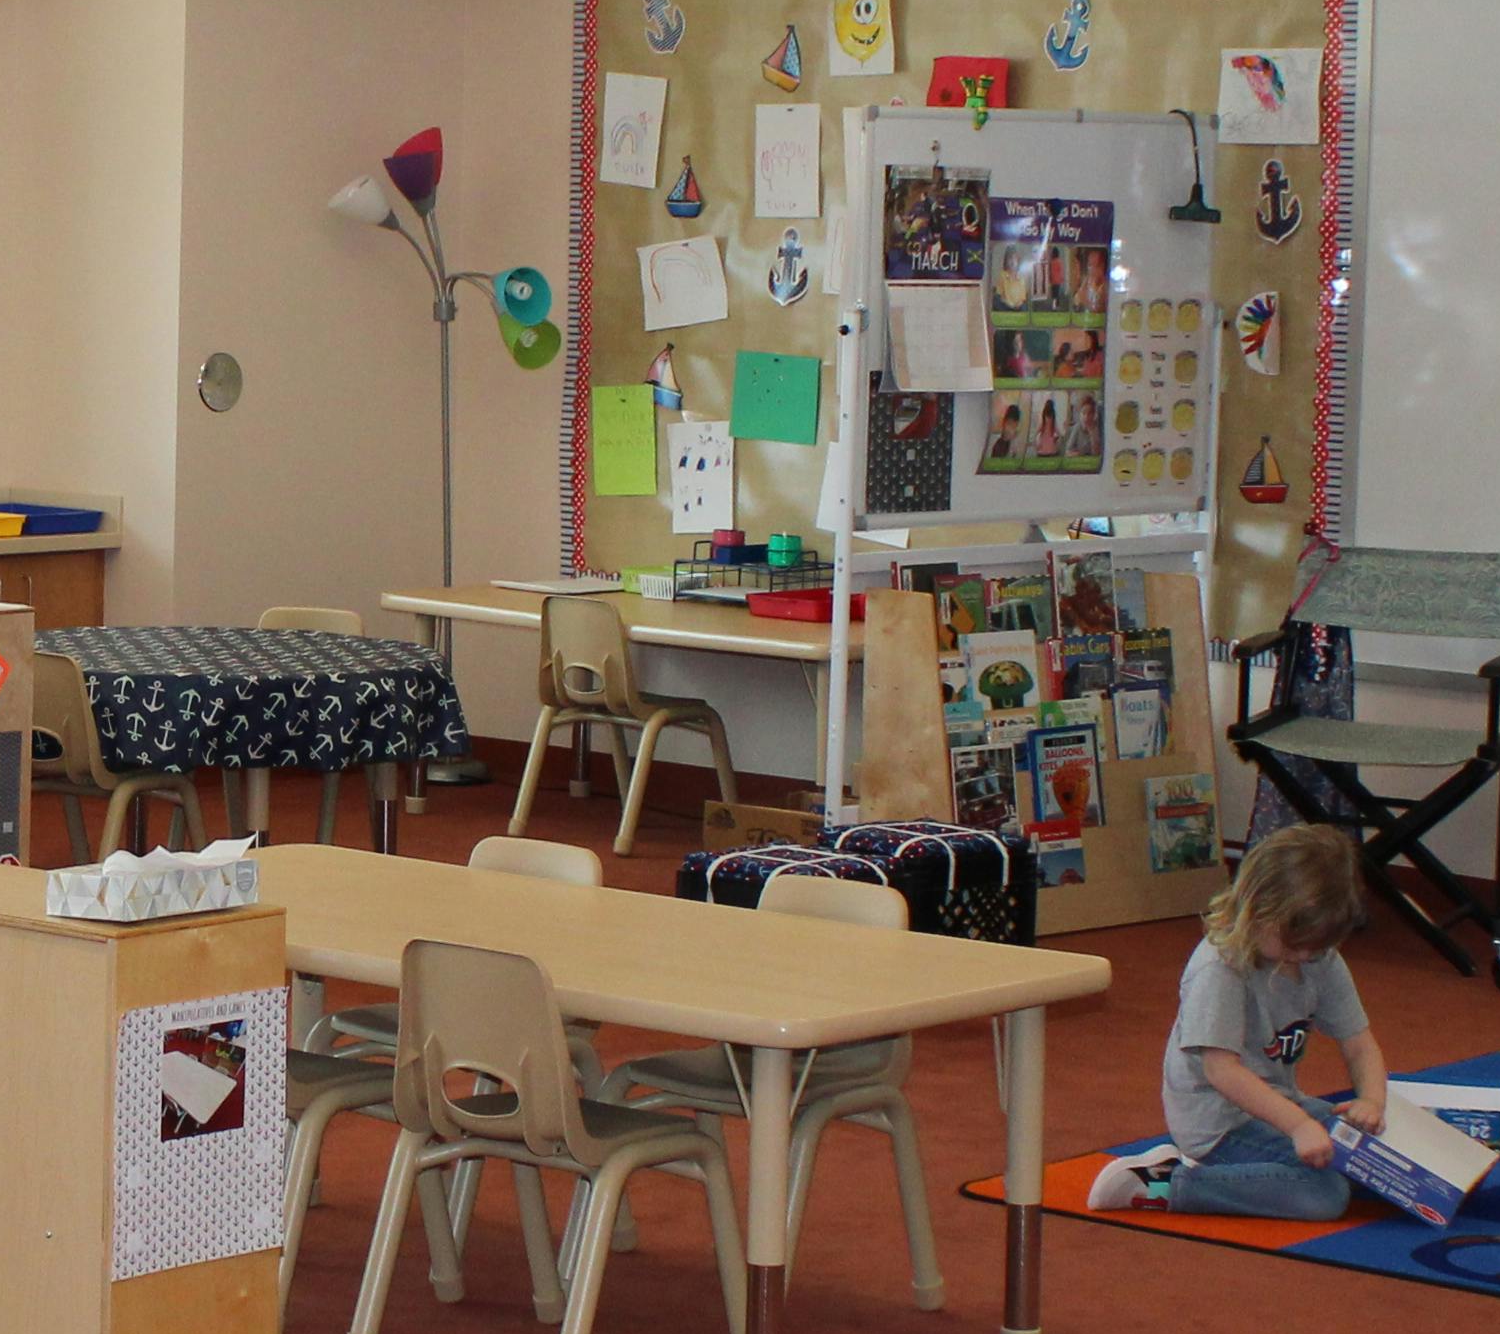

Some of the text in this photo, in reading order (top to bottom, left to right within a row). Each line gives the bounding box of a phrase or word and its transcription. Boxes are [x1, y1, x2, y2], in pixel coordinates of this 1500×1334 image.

[1004, 201, 1036, 216] When
[1071, 201, 1099, 218] Don't
[1058, 222, 1081, 240] Way
[1469, 1124, 1491, 1138] 24
